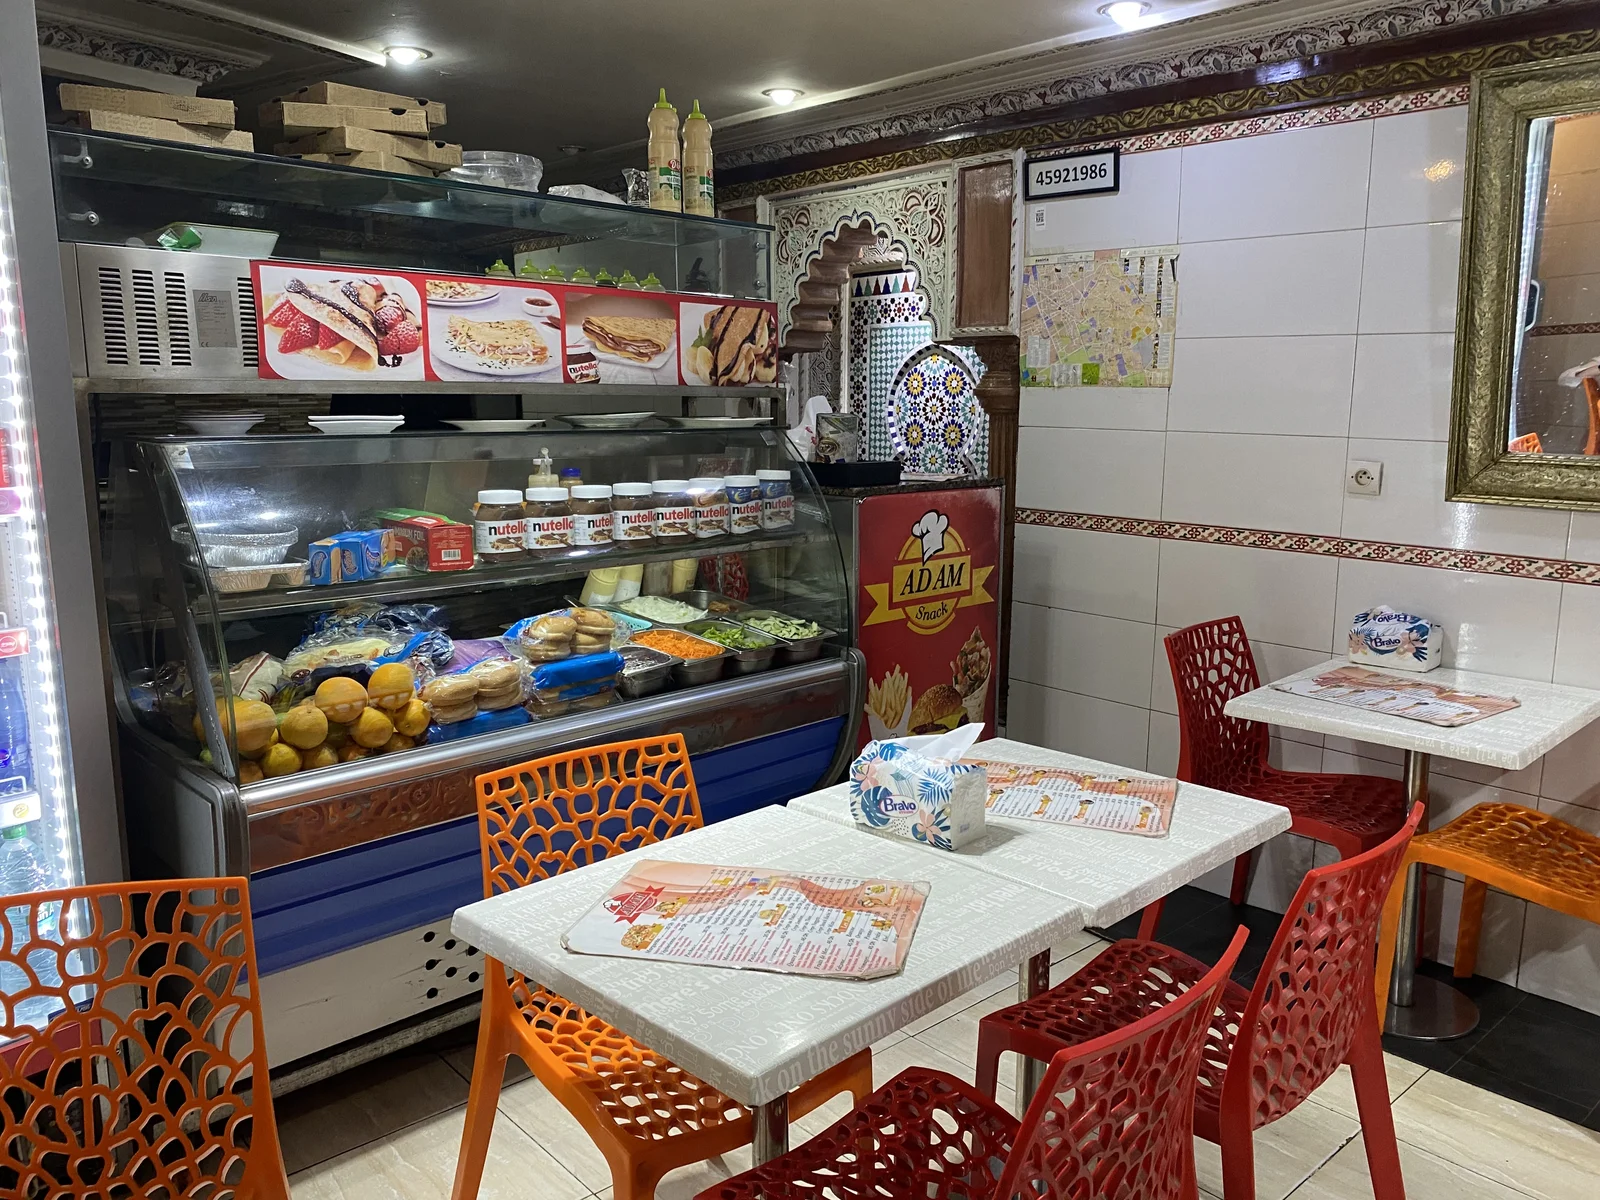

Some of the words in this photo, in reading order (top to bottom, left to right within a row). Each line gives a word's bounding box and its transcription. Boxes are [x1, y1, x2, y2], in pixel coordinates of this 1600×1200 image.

[1036, 163, 1107, 186] 45921986
[568, 362, 598, 374] nutella
[657, 508, 695, 520] nutella
[695, 506, 729, 518] nutella
[588, 513, 614, 528] nutell
[899, 562, 966, 596] ADAM
[915, 601, 948, 621] Snack
[1373, 637, 1401, 647] Bravo
[883, 797, 917, 812] Bravo
[760, 1009, 820, 1038] ONLY
[776, 1062, 804, 1090] on
[807, 1042, 839, 1076] the
[842, 1008, 897, 1056] sunny
[900, 988, 934, 1023] side
